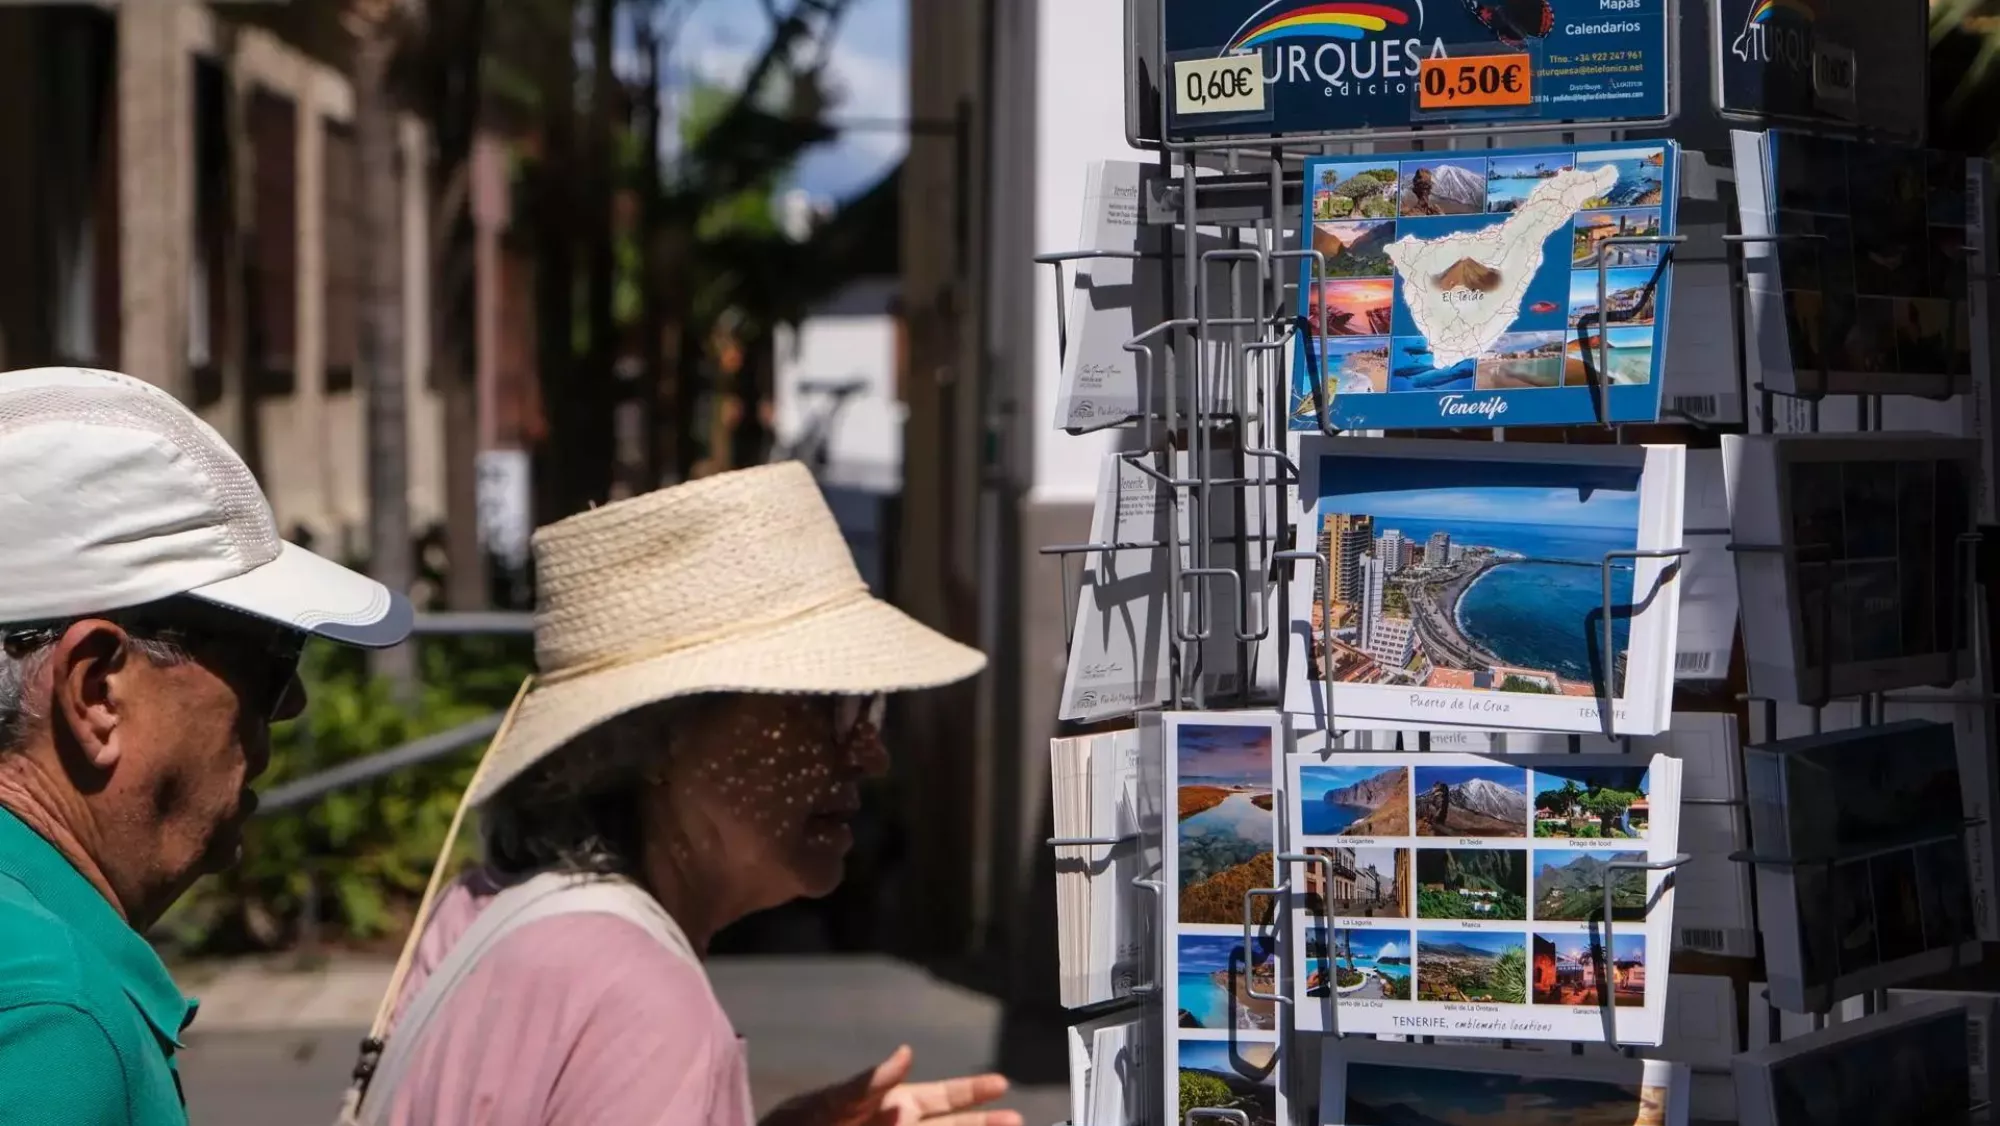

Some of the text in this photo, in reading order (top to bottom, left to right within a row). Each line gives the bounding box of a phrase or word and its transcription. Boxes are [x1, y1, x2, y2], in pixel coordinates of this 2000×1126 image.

[1600, 0, 1641, 11] Mapas
[1565, 21, 1641, 35] Calendarios
[1229, 37, 1448, 86] URQUESA
[1592, 52, 1608, 61] 922
[1609, 51, 1626, 60] 247
[1627, 51, 1642, 59] 961
[1187, 67, 1254, 105] 0,60€
[1425, 64, 1523, 100] 0,50€
[1442, 289, 1484, 302] El Teide
[1438, 395, 1508, 420] Tenerife
[1409, 694, 1511, 712] Puerto de la Cruz
[1430, 732, 1467, 744] enerife
[1349, 837, 1375, 846] Gigantes
[1569, 840, 1588, 848] Drago
[1351, 919, 1372, 927] Laguna
[1393, 1016, 1553, 1032] TENERIFE, emblematic locations
